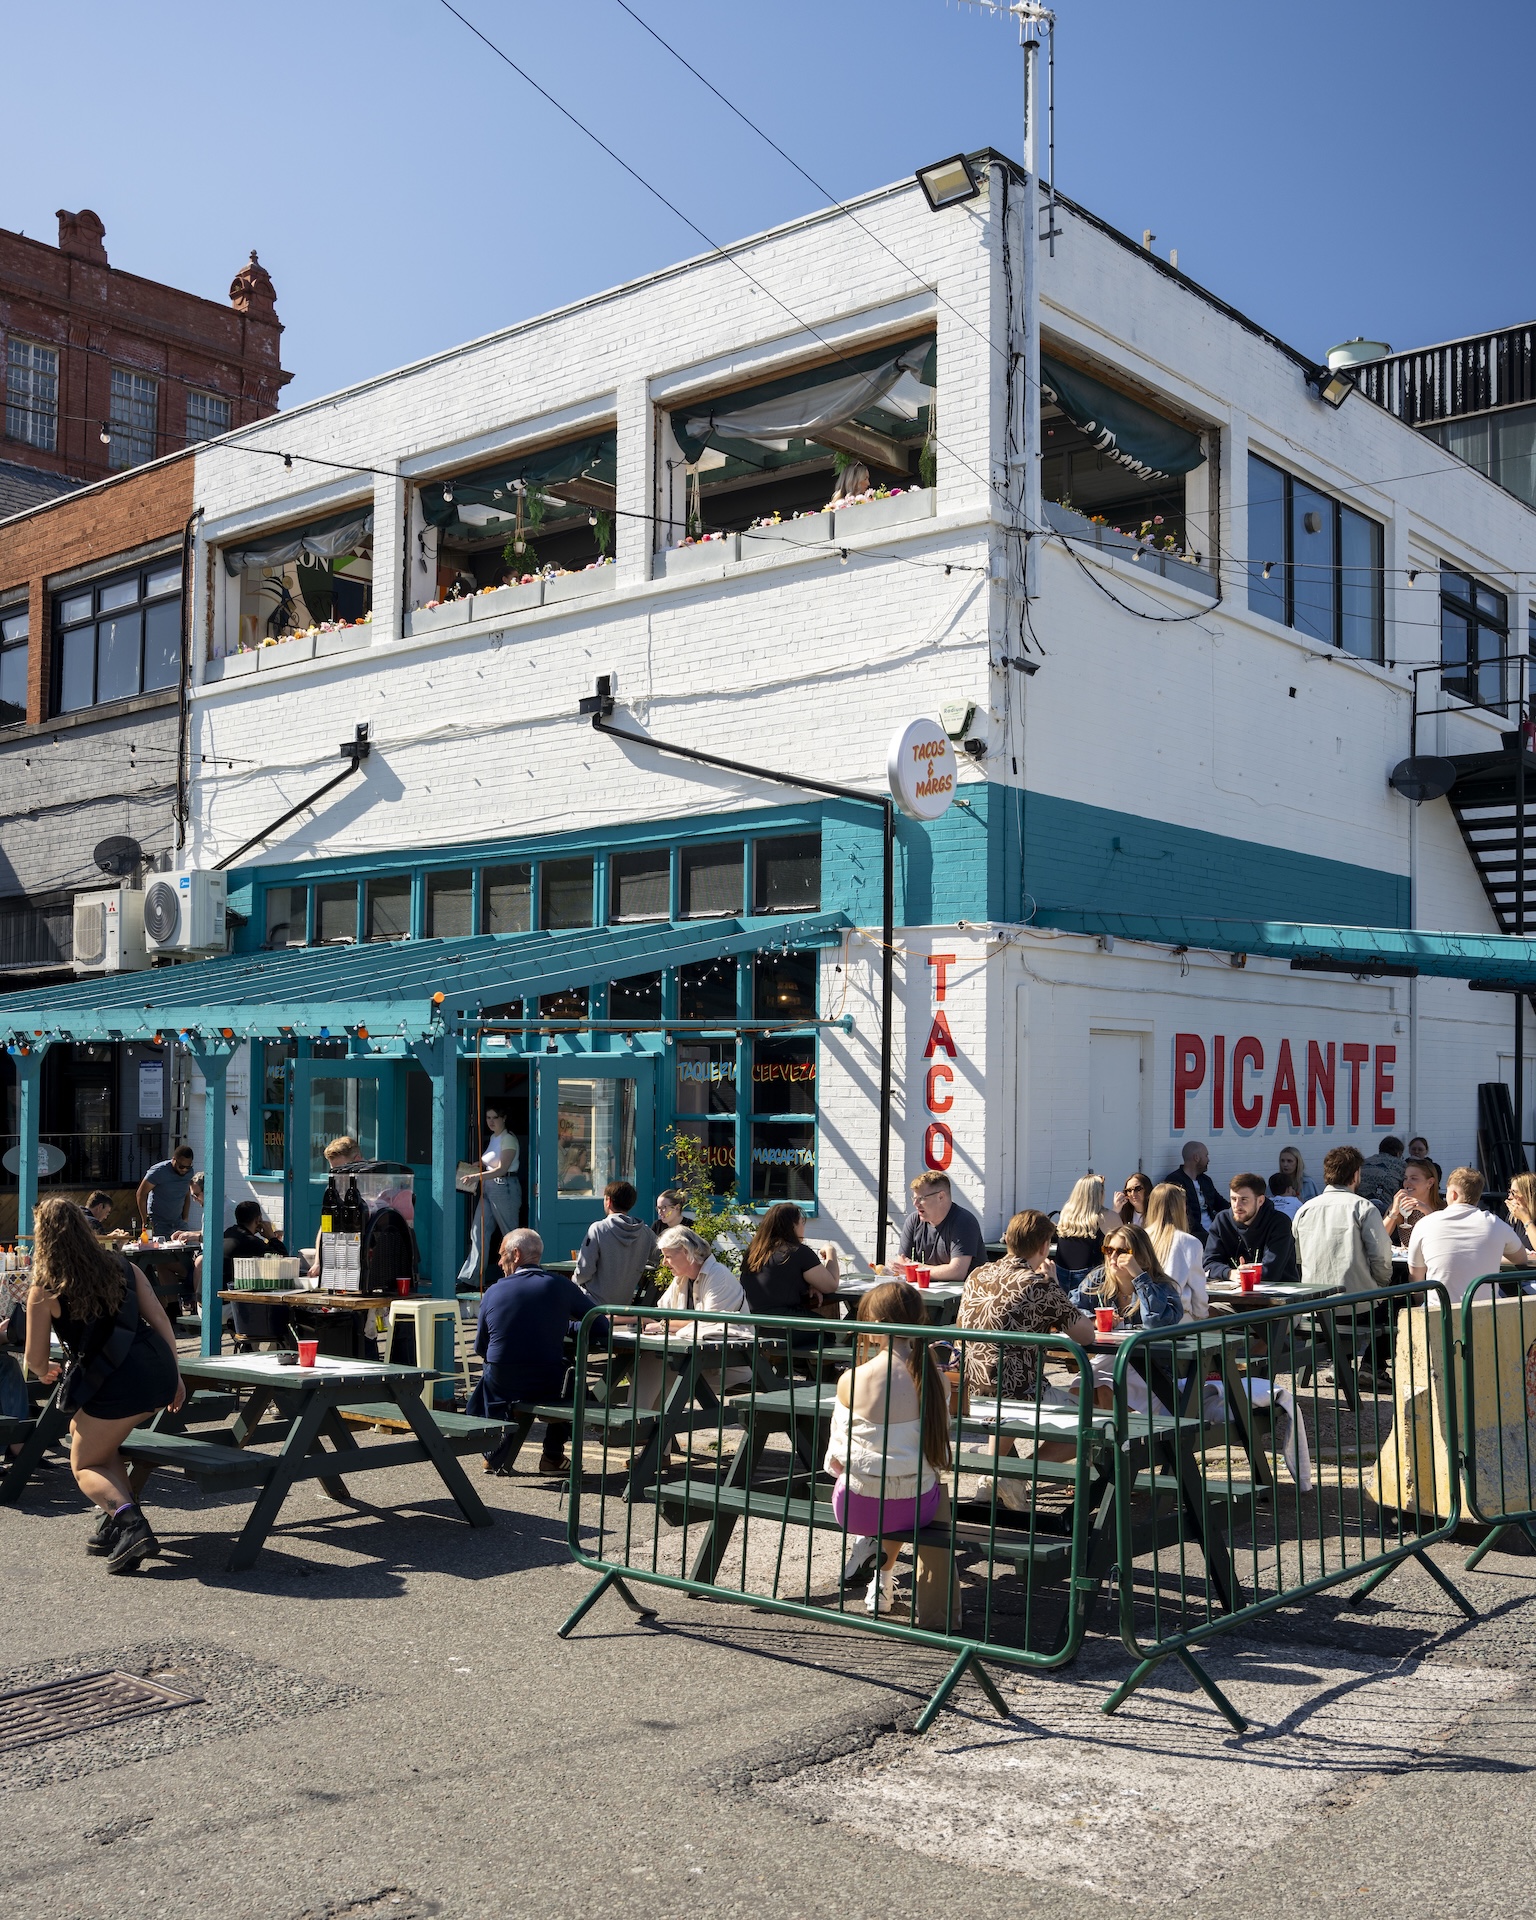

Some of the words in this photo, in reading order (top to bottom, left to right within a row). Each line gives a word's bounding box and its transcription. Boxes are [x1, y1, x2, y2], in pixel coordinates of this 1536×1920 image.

[296, 551, 329, 572] ON
[912, 739, 946, 762] TACOS
[927, 759, 934, 779] &
[916, 774, 953, 799] MARGS
[923, 954, 957, 1172] TACO
[1172, 1033, 1396, 1133] PICANTE
[677, 1145, 736, 1168] CHOS
